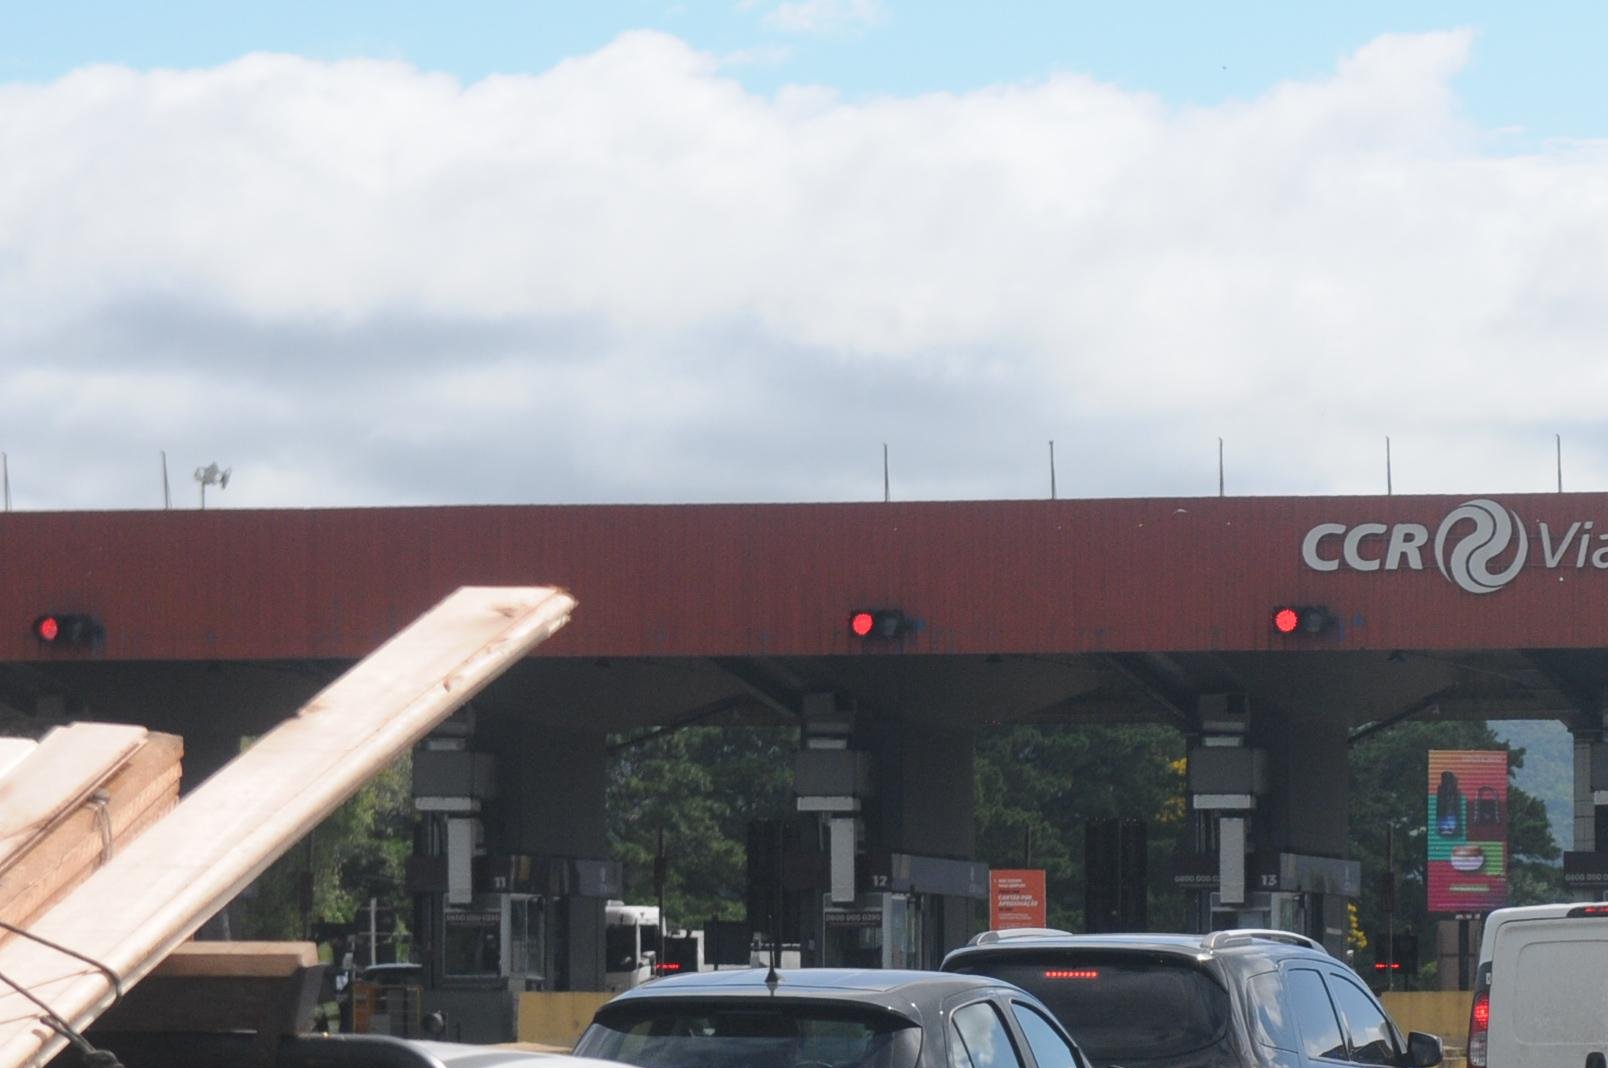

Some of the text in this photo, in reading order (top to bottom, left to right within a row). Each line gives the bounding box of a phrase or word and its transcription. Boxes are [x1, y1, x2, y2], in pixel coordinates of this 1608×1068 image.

[1302, 523, 1428, 571] CCR
[494, 876, 506, 888] 11
[872, 875, 887, 887] 12
[1261, 874, 1278, 886] 13
